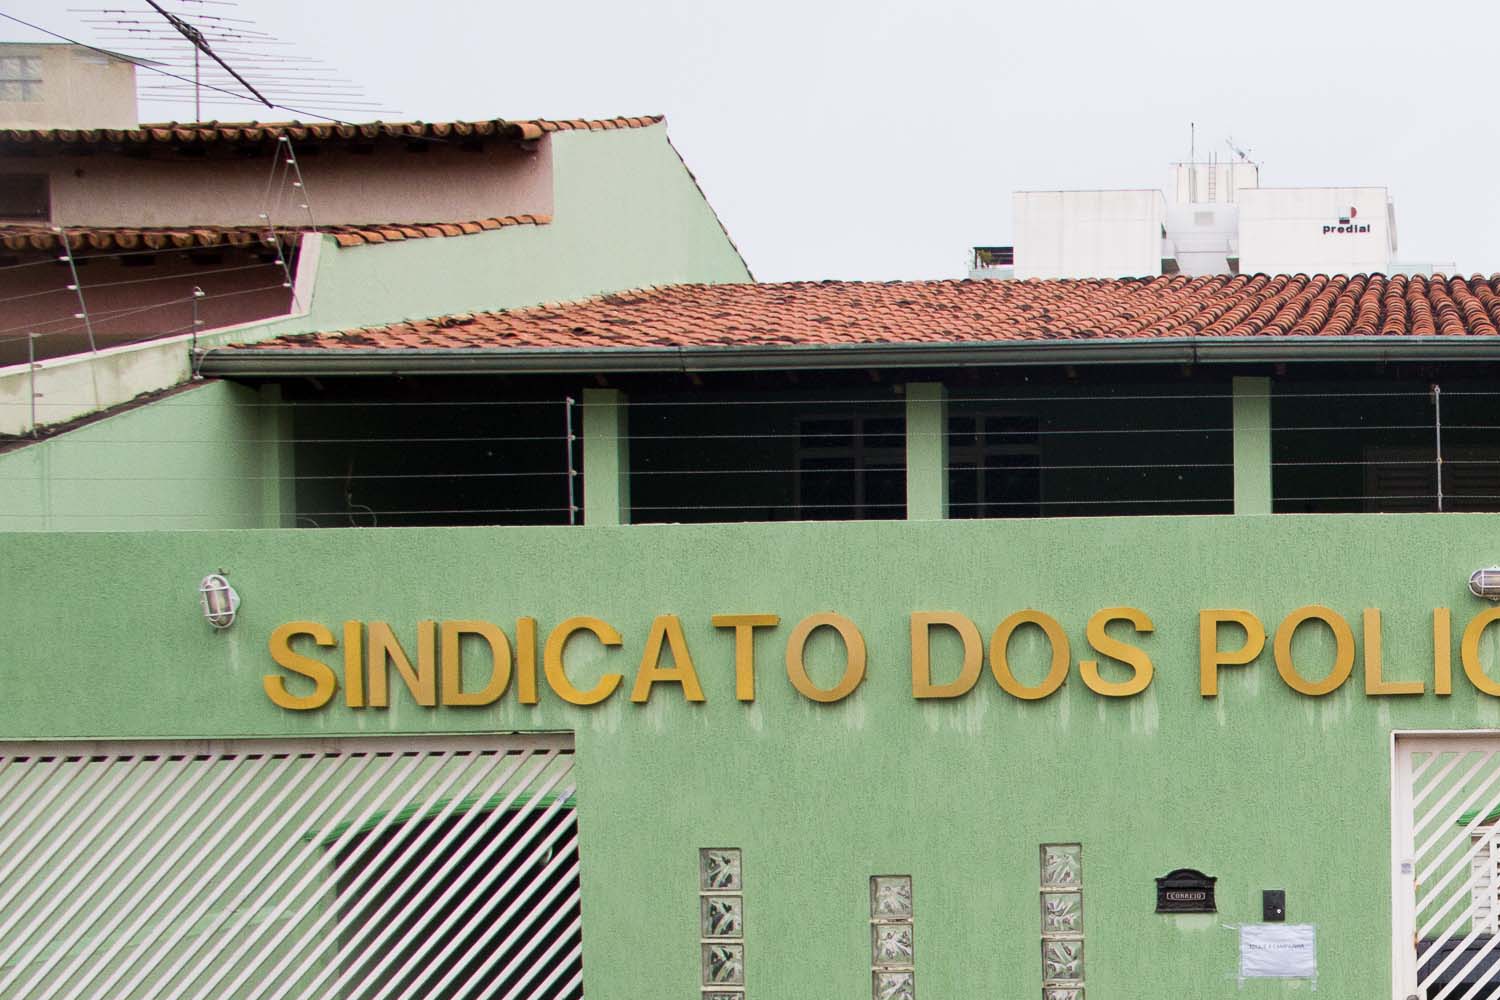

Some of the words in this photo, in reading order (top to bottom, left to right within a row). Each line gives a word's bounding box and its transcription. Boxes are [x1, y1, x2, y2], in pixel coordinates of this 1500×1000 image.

[1322, 224, 1371, 235] predial
[263, 611, 870, 710] SINDICATO
[911, 608, 1156, 700] DOS
